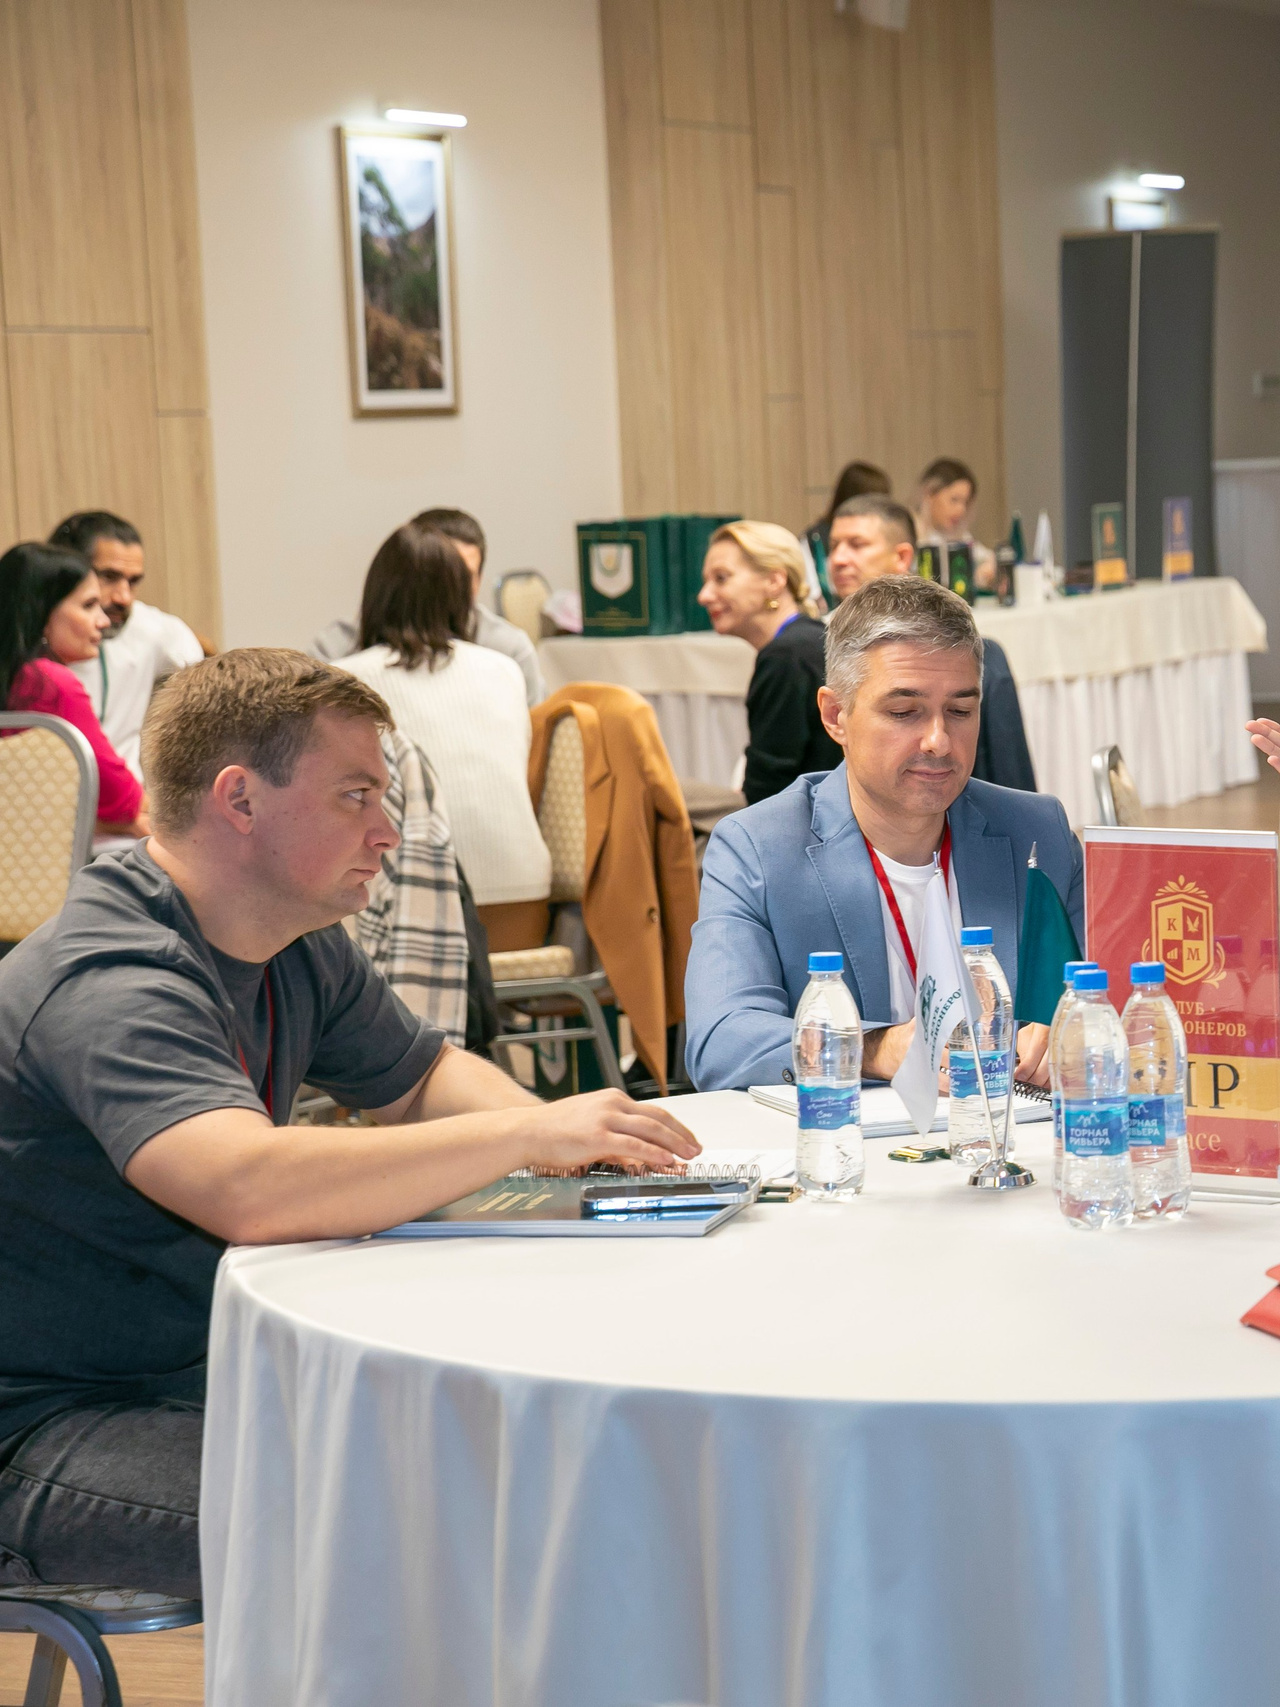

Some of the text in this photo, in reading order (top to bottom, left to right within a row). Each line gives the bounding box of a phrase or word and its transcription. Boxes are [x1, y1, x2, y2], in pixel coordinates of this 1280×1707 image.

[1175, 1000, 1205, 1016] ЛУБ
[1184, 1020, 1247, 1037] ОНЕРОВ
[1187, 1061, 1240, 1109] IP
[1070, 1128, 1109, 1137] ГОРНАЯ
[1129, 1128, 1161, 1136] ВЬЕРА
[1069, 1137, 1111, 1147] РИВЬЕРА
